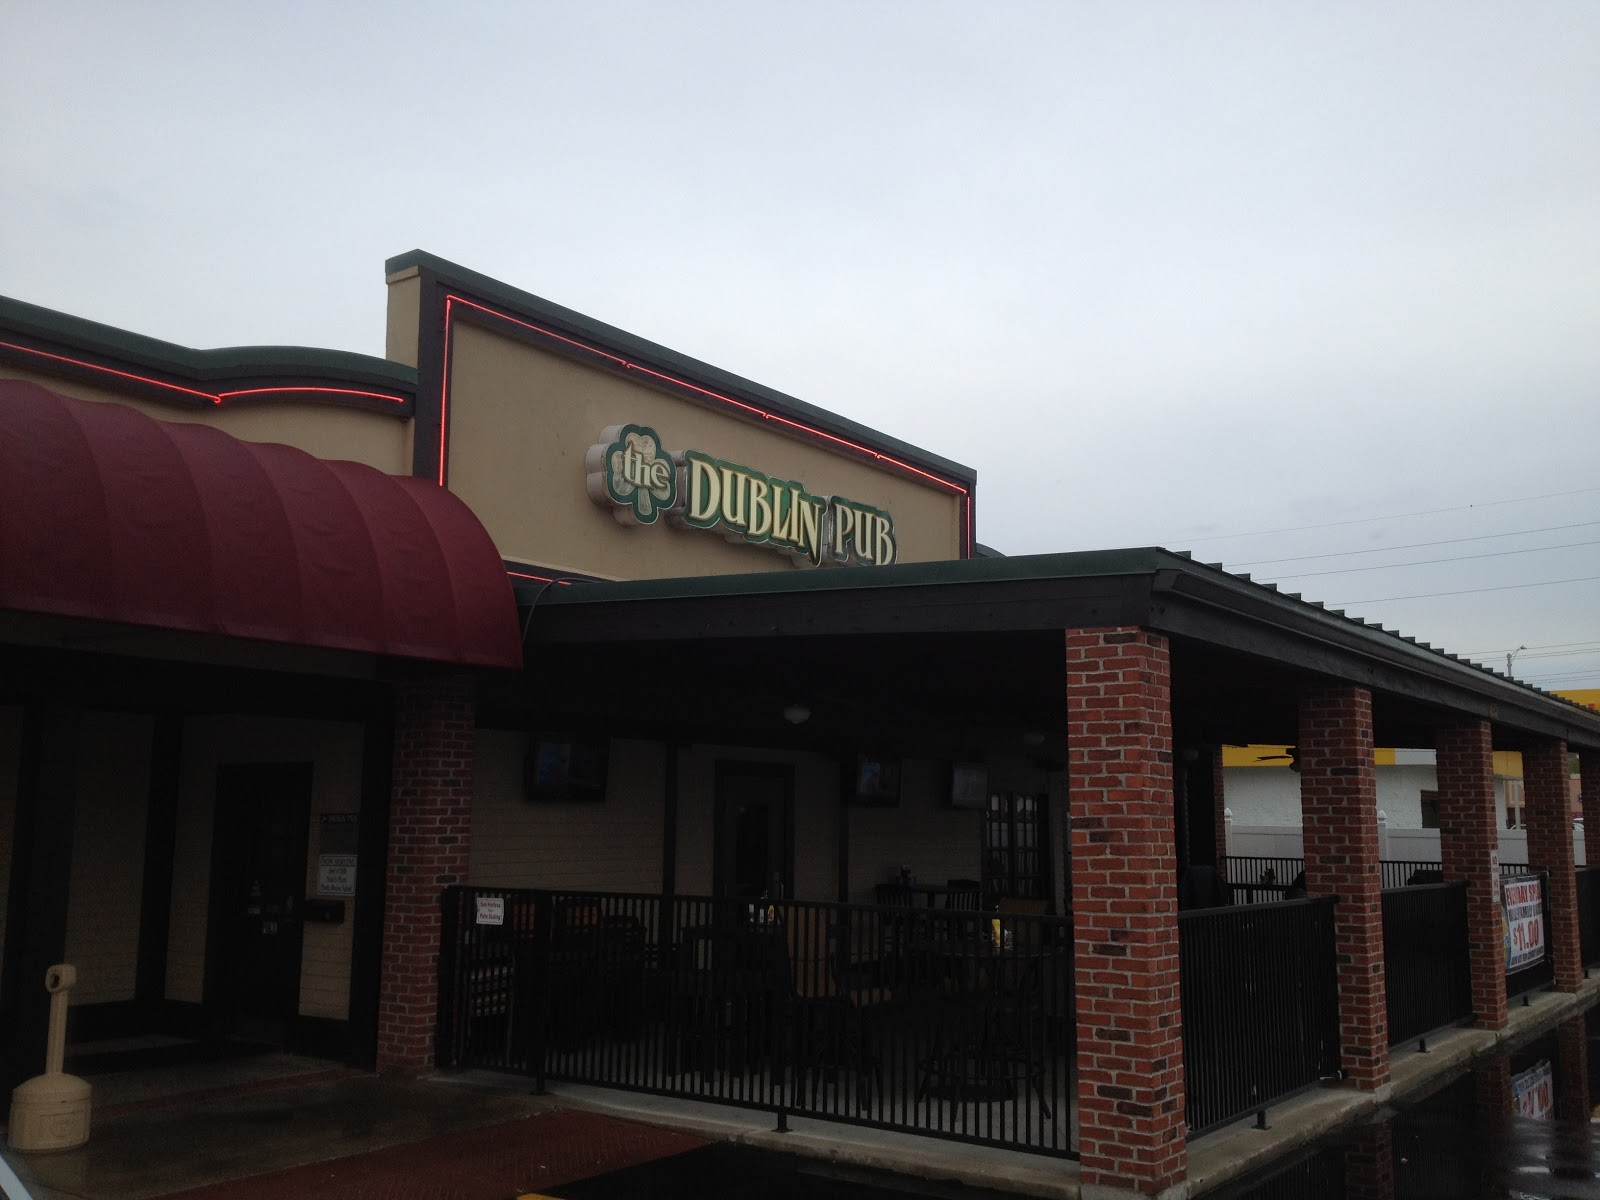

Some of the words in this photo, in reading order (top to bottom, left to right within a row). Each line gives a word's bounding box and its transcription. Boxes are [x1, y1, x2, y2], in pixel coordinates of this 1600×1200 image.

[623, 442, 670, 487] the
[689, 457, 822, 558] DUBLIN
[832, 502, 893, 565] PUB
[1512, 919, 1539, 951] $11.00
